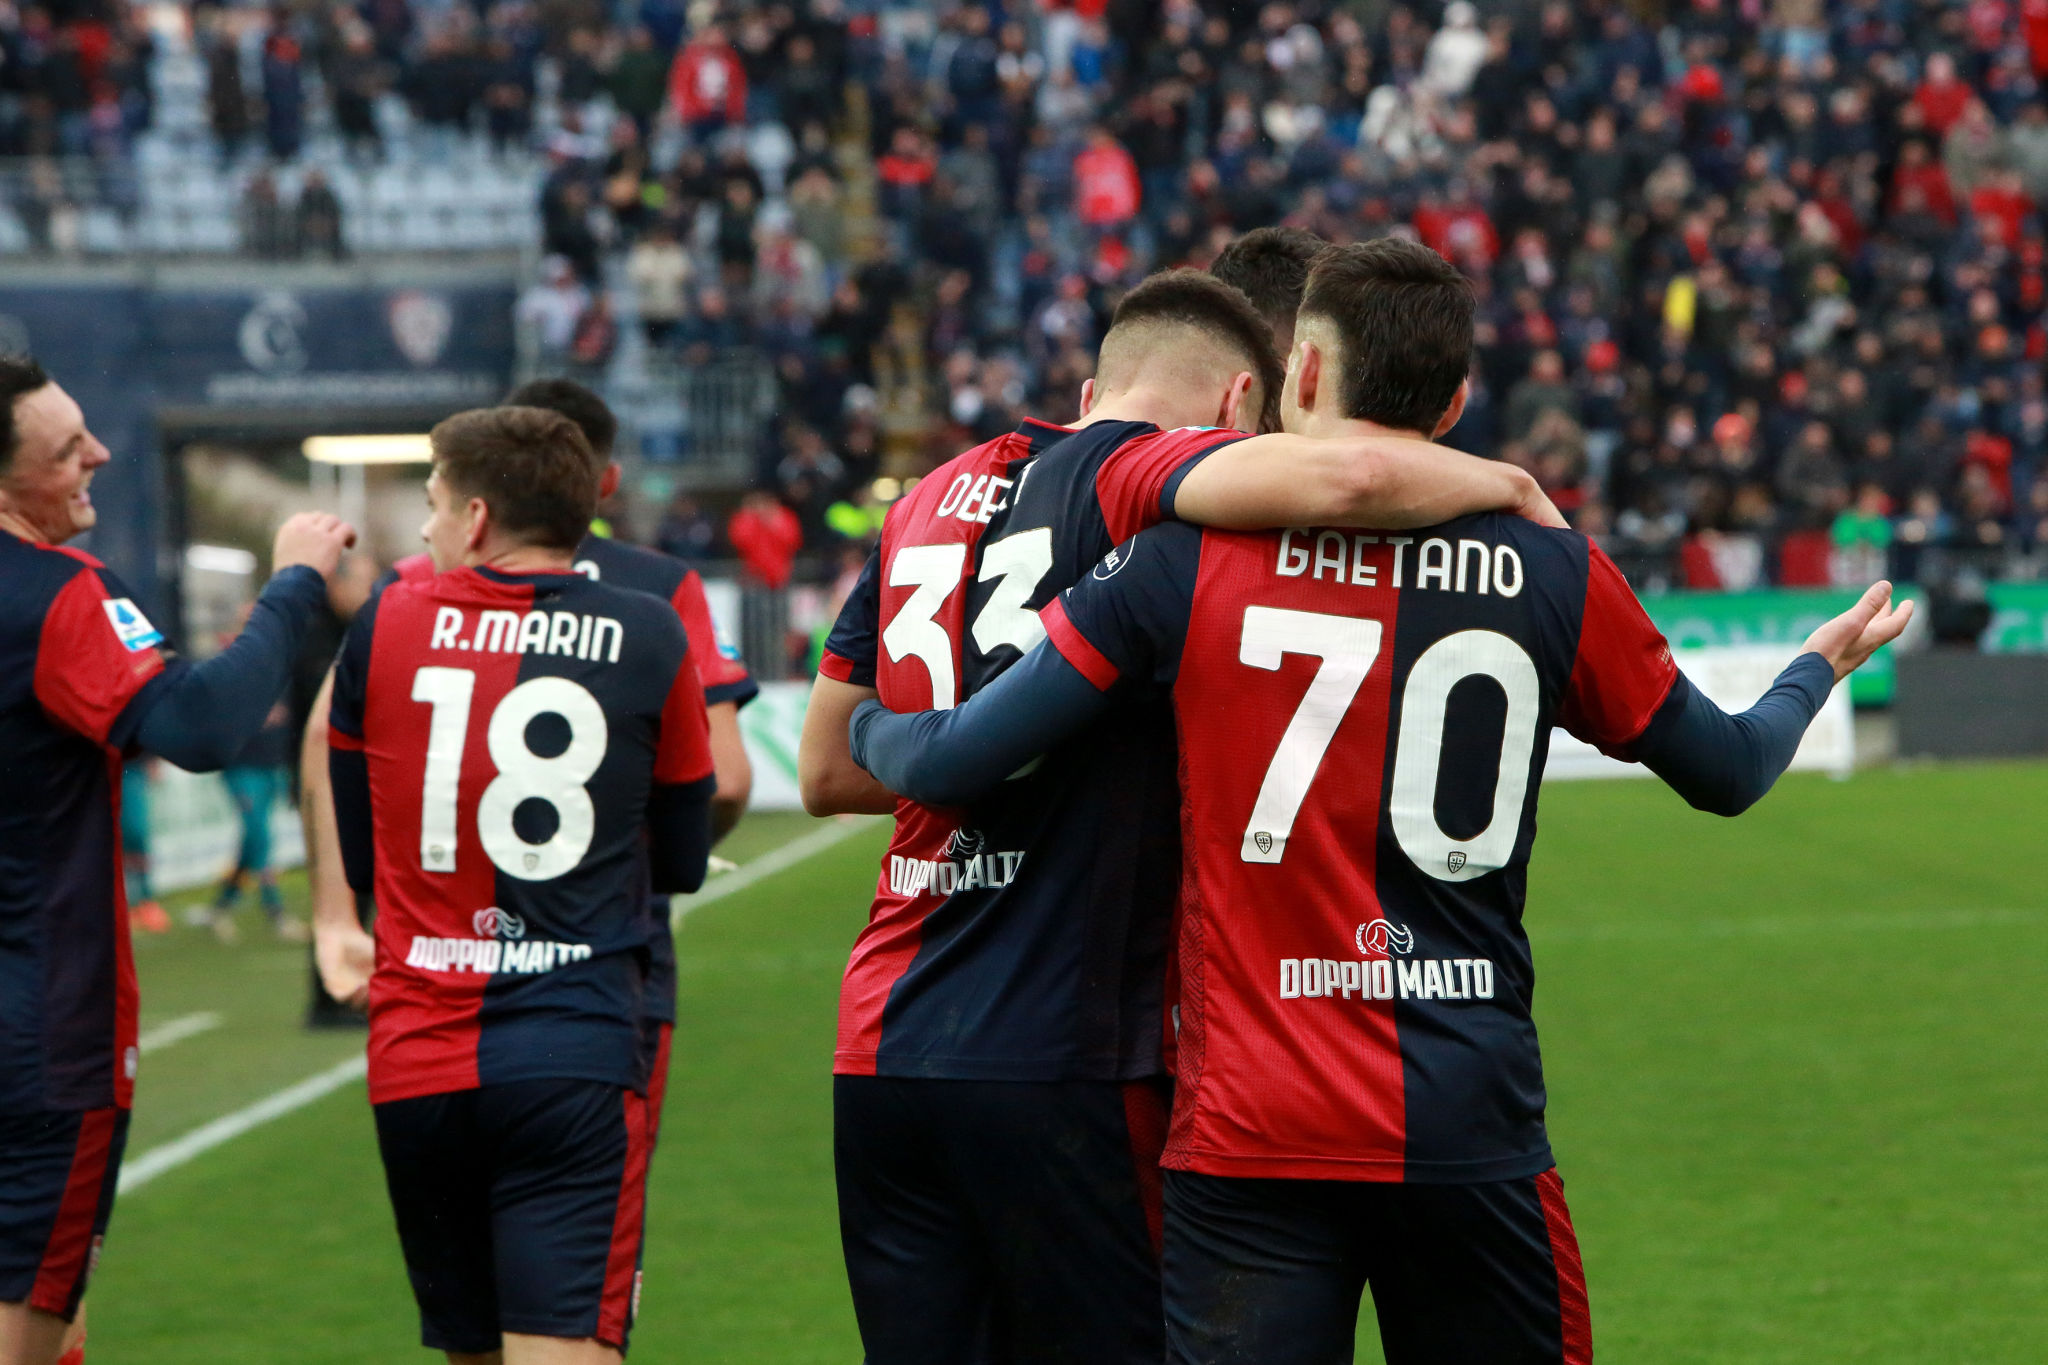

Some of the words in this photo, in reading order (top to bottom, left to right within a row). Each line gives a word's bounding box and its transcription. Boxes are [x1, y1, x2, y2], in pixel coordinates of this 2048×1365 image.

[1276, 527, 1524, 598] GAETANO
[430, 606, 624, 663] R.MARIN
[883, 527, 1053, 782] 33
[411, 666, 608, 881] 18
[1239, 605, 1540, 882] 70
[405, 936, 501, 973] DOPPIO
[1280, 958, 1394, 999] DOPPIO
[1397, 959, 1494, 999] MALTO
